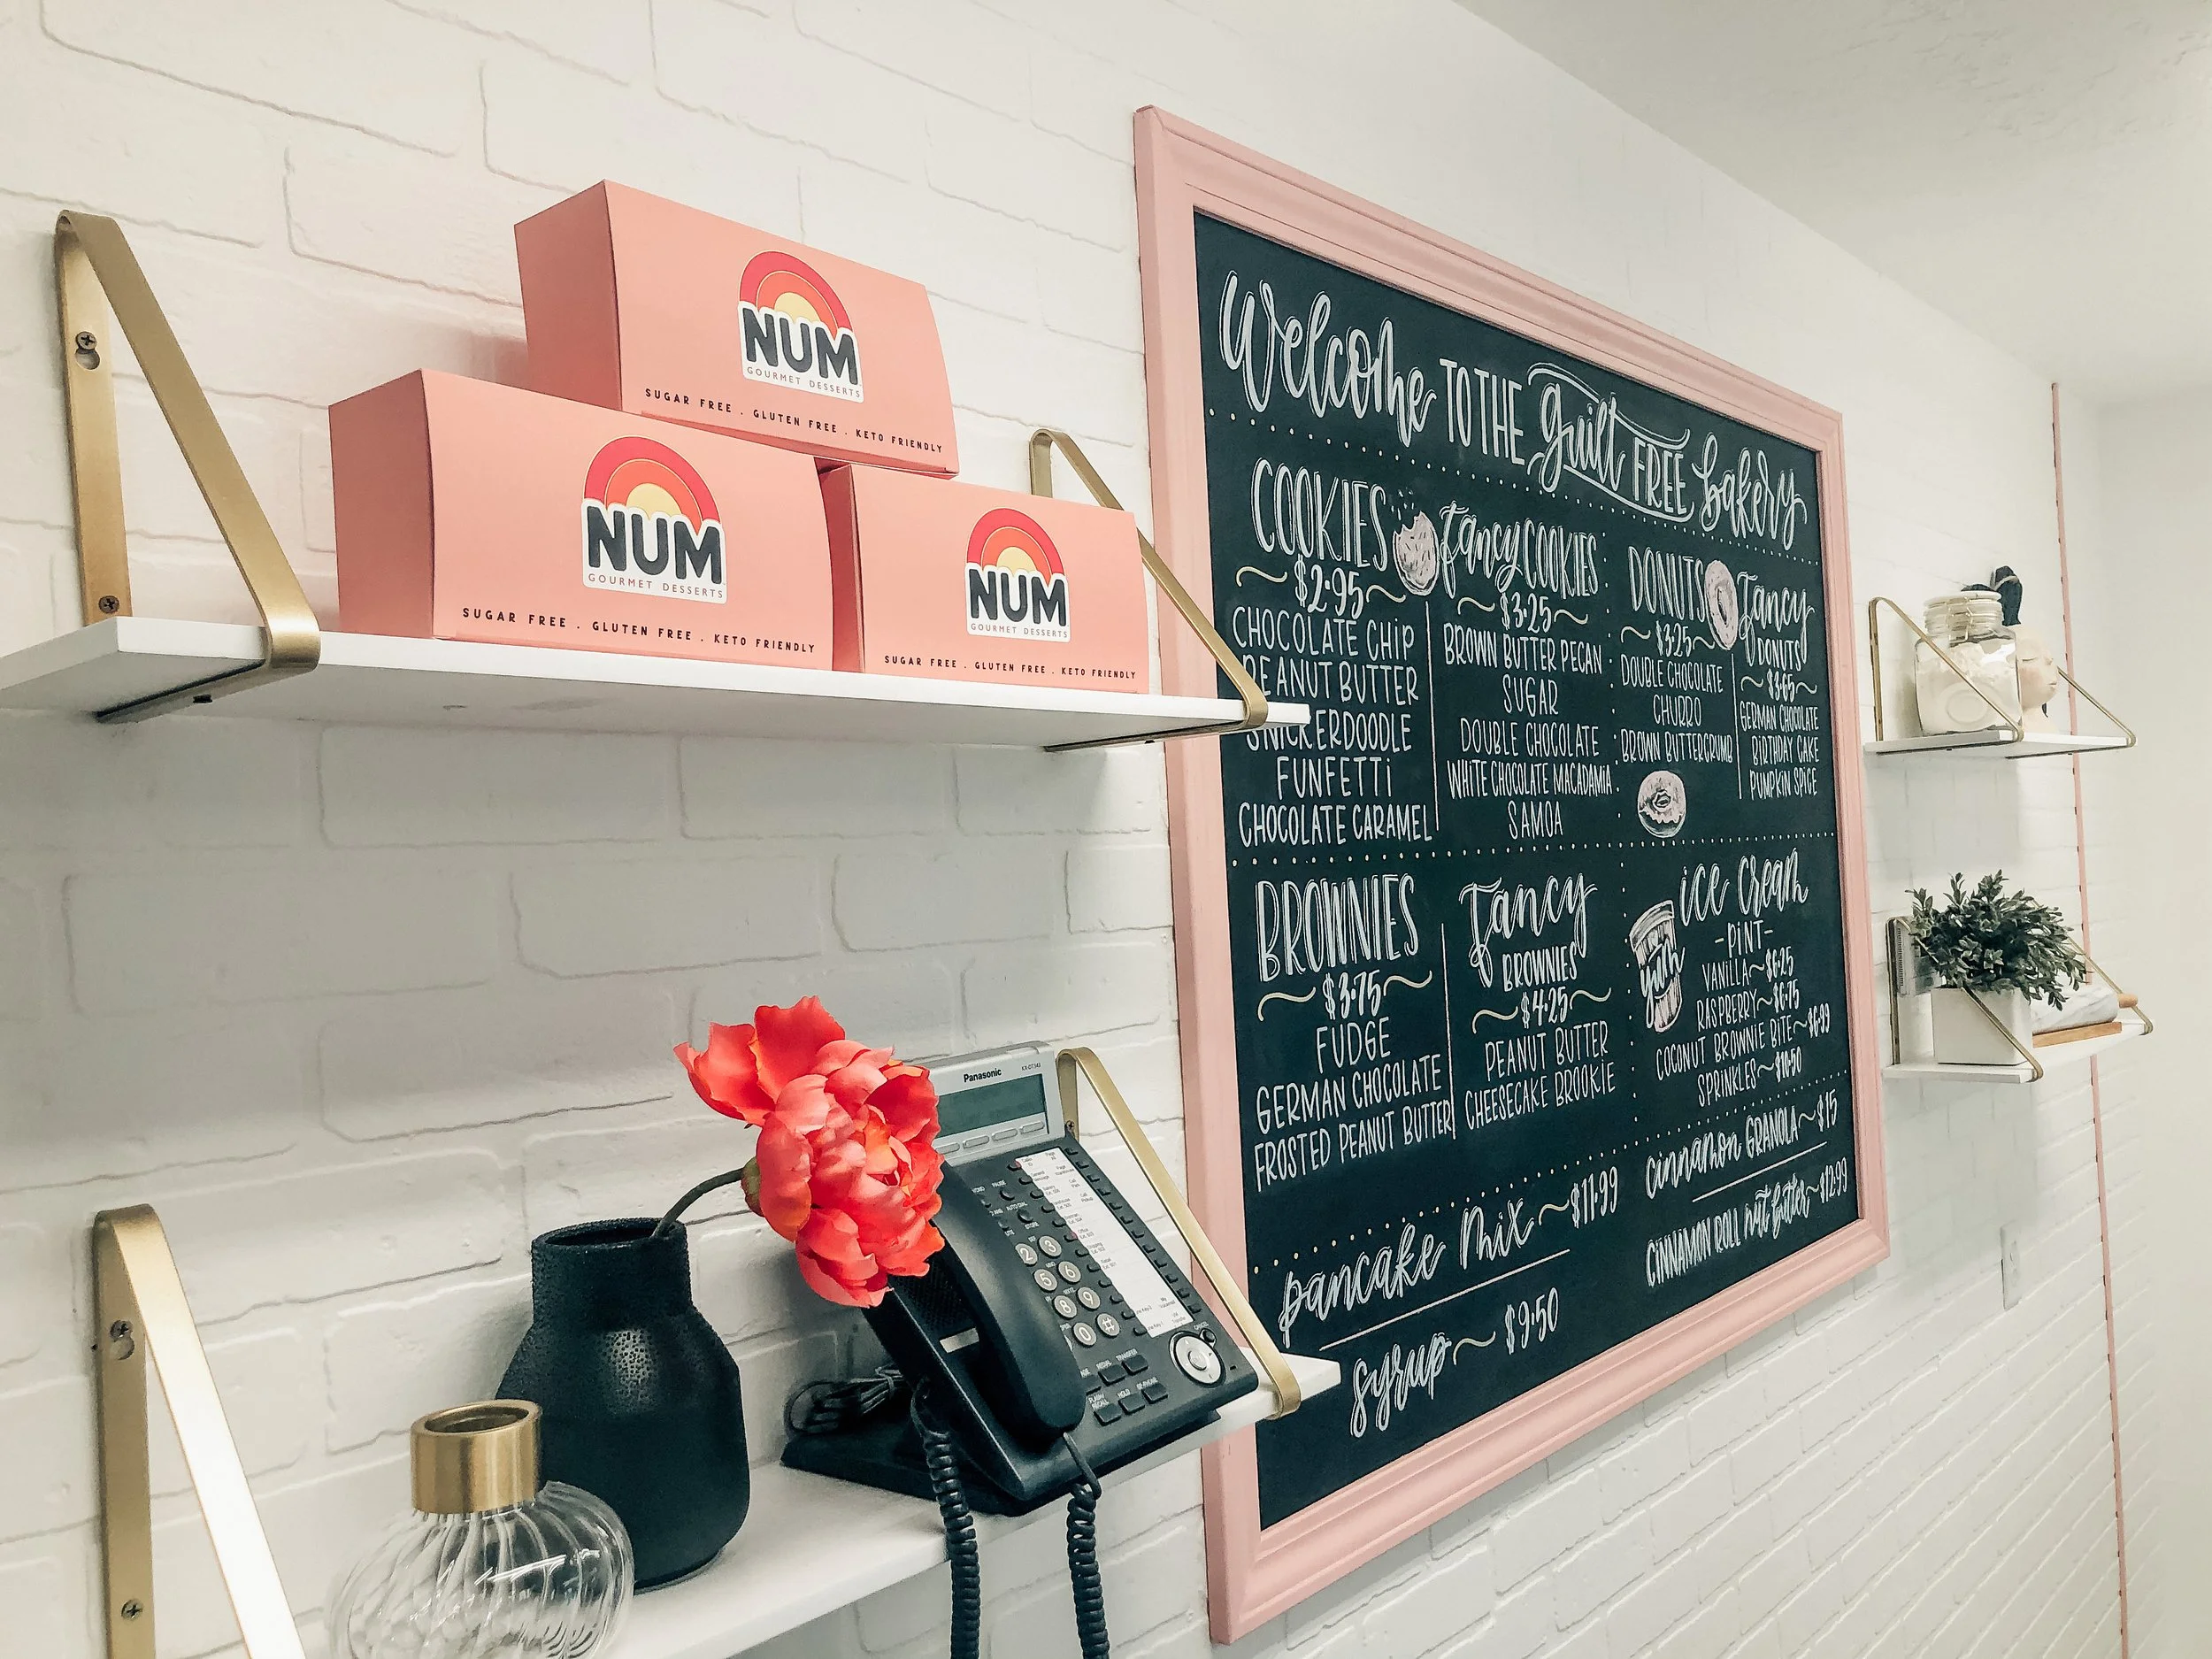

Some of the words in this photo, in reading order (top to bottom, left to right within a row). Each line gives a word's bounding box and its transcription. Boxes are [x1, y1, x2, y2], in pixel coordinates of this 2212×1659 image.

[741, 307, 859, 386] NUM
[747, 366, 801, 385] GOURMET
[810, 380, 861, 398] DESSERTS
[645, 388, 690, 405] SUGAR
[701, 400, 732, 413] FREE
[753, 408, 800, 426] GLUTEN
[809, 419, 837, 434] FREE
[856, 429, 885, 442] KETO
[891, 436, 943, 454] FRIENDLY
[1219, 271, 1437, 447] Welcome
[1440, 358, 1471, 447] TO
[1474, 368, 1525, 465] THE
[1632, 437, 1686, 515] FREE
[1692, 432, 1807, 550] bakery
[1251, 457, 1387, 572] COOKIES
[587, 506, 722, 585] NUM
[1523, 518, 1598, 599] COOKIES
[588, 573, 653, 589] GOURMET
[663, 583, 724, 598] DESSERTS
[969, 569, 1066, 626] NUM
[1628, 546, 1705, 622] DONUTS
[463, 608, 516, 623] SUGAR
[529, 615, 566, 627] FREE
[592, 621, 648, 636] GLUTEN
[658, 628, 692, 641] FREE
[714, 634, 747, 645] KETO
[756, 639, 815, 653] FRIENDLY
[971, 623, 1017, 634] GOURMET
[1024, 627, 1068, 638] DESSERTS
[1233, 606, 1359, 657] CHOCOLATE
[1443, 623, 1498, 668] BROWN
[1503, 634, 1557, 672] BUTTER
[1561, 640, 1602, 674] PECAN
[1757, 637, 1801, 672] DONUTS
[885, 655, 922, 666] SUGAR
[930, 658, 957, 669] FREE
[974, 661, 1014, 672] GLUTEN
[1021, 664, 1045, 674] FREE
[1062, 667, 1086, 676] KETO
[1092, 669, 1136, 680] FRIENDLY
[1242, 655, 1333, 699] PEANUT
[1339, 661, 1418, 705] BUTTER
[1621, 653, 1663, 687] DOUBLE
[1667, 661, 1723, 693] CHOCOLATE
[1502, 674, 1558, 717] SUGAR
[1654, 695, 1701, 727] CHURRO
[1740, 701, 1777, 732] GERMAN
[1779, 704, 1819, 733] CHOCOLATE
[1461, 718, 1519, 757] DOUBLE
[1525, 722, 1599, 758] CHOCOLATE
[1621, 728, 1661, 763] BROWN
[1664, 731, 1732, 764] BUTTERCRUMB
[1797, 734, 1819, 764] CAKE
[1491, 760, 1549, 796] CHOCOLATE
[1239, 802, 1347, 848] CHOCOLATE
[1353, 803, 1432, 841] CARAMEL
[1508, 800, 1563, 840] SAMOA
[1679, 864, 1730, 926] ice
[1255, 872, 1418, 982] BROWNIES
[1502, 941, 1578, 992] BROWNIES
[1696, 988, 1757, 1032] RASPBERRY
[1317, 1017, 1391, 1073] FUDGE
[1485, 1033, 1547, 1081] PEANUT
[1555, 1020, 1608, 1065] BUTTER
[1655, 1036, 1706, 1081] COCONUT
[964, 1067, 1002, 1083] Panasonic
[1256, 1076, 1346, 1134] GERMAN
[1352, 1054, 1441, 1109] CHOCOLATE
[1465, 1075, 1548, 1130] CHEESECAKE
[1745, 1105, 1799, 1159] GRANOLA
[1817, 1089, 1837, 1132] $15
[1254, 1128, 1331, 1192] FROSTED
[1339, 1110, 1394, 1164] PEANUT
[1402, 1099, 1452, 1145] BUTTER
[1714, 1208, 1741, 1253] ROLL
[1279, 1221, 1446, 1349] pancake
[1350, 1332, 1452, 1438] syrup
